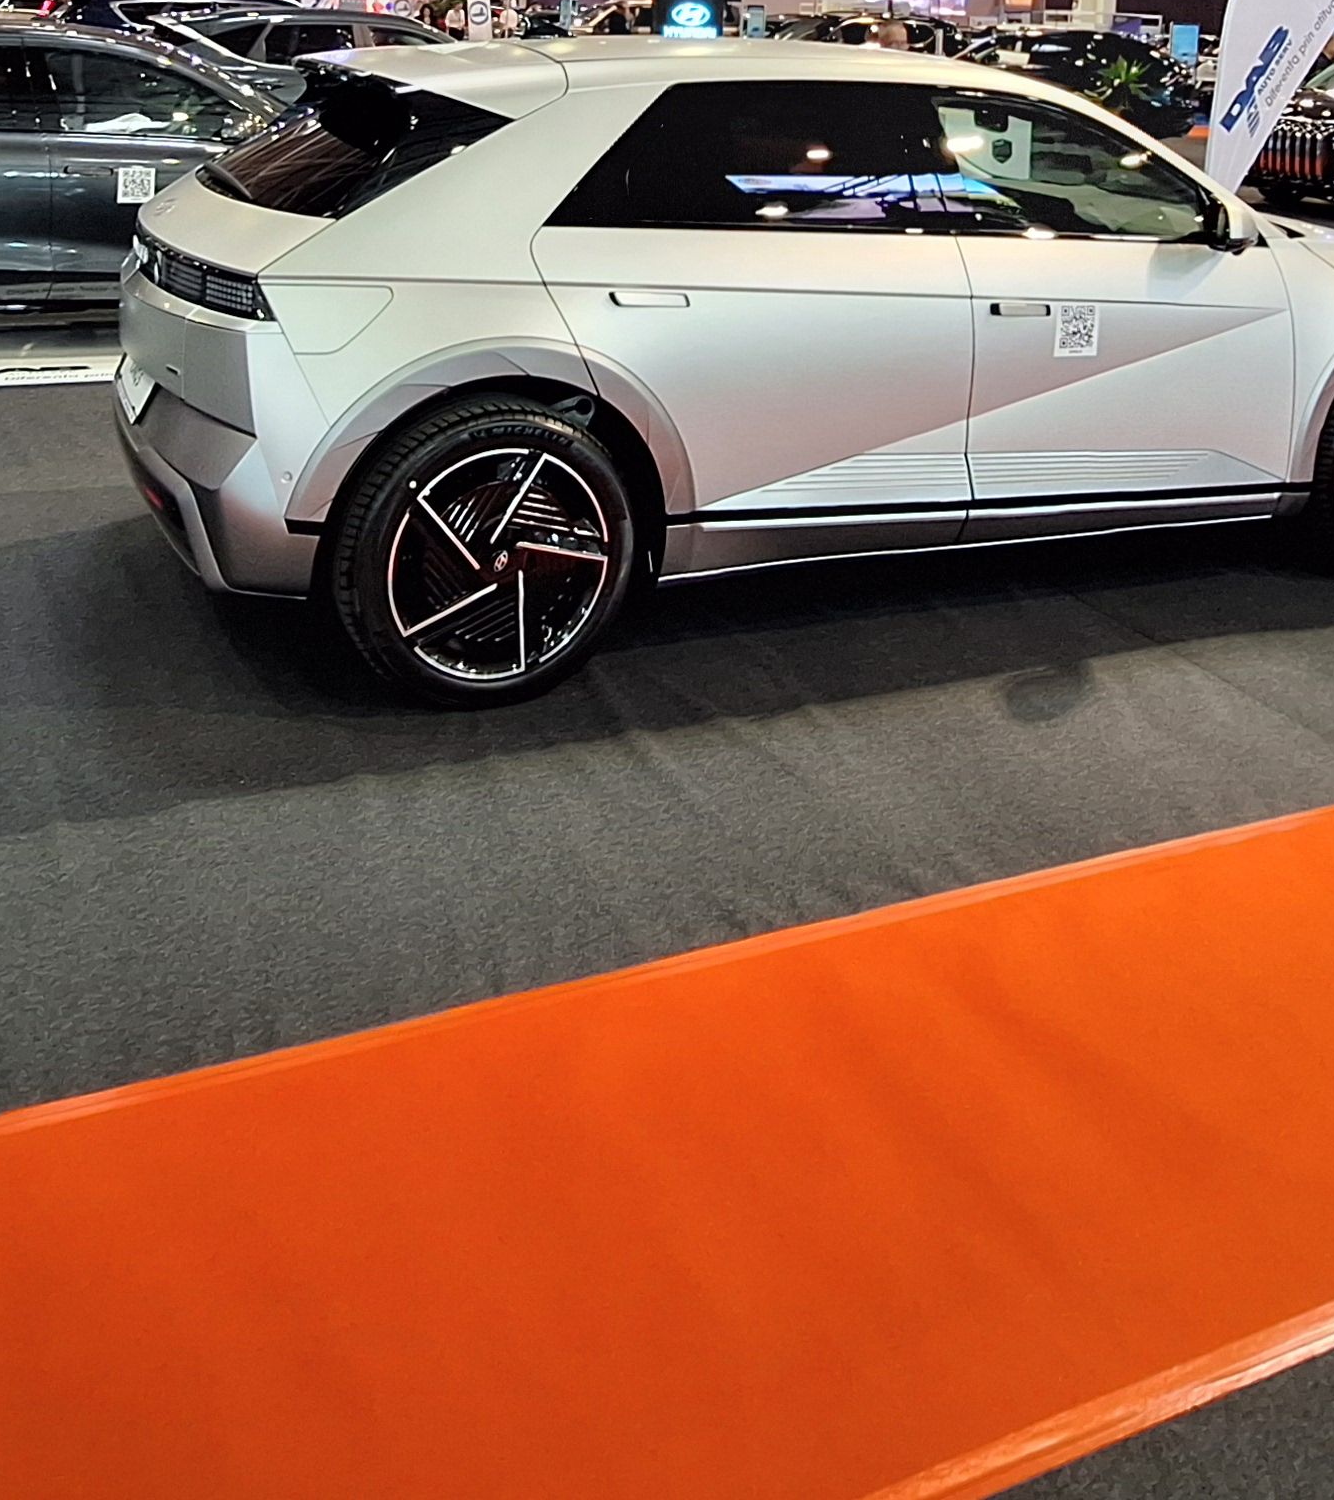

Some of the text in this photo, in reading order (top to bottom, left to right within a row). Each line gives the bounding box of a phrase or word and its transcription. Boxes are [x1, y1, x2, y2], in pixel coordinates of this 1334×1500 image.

[1299, 31, 1315, 58] prin
[1256, 38, 1293, 96] AUTO SERV
